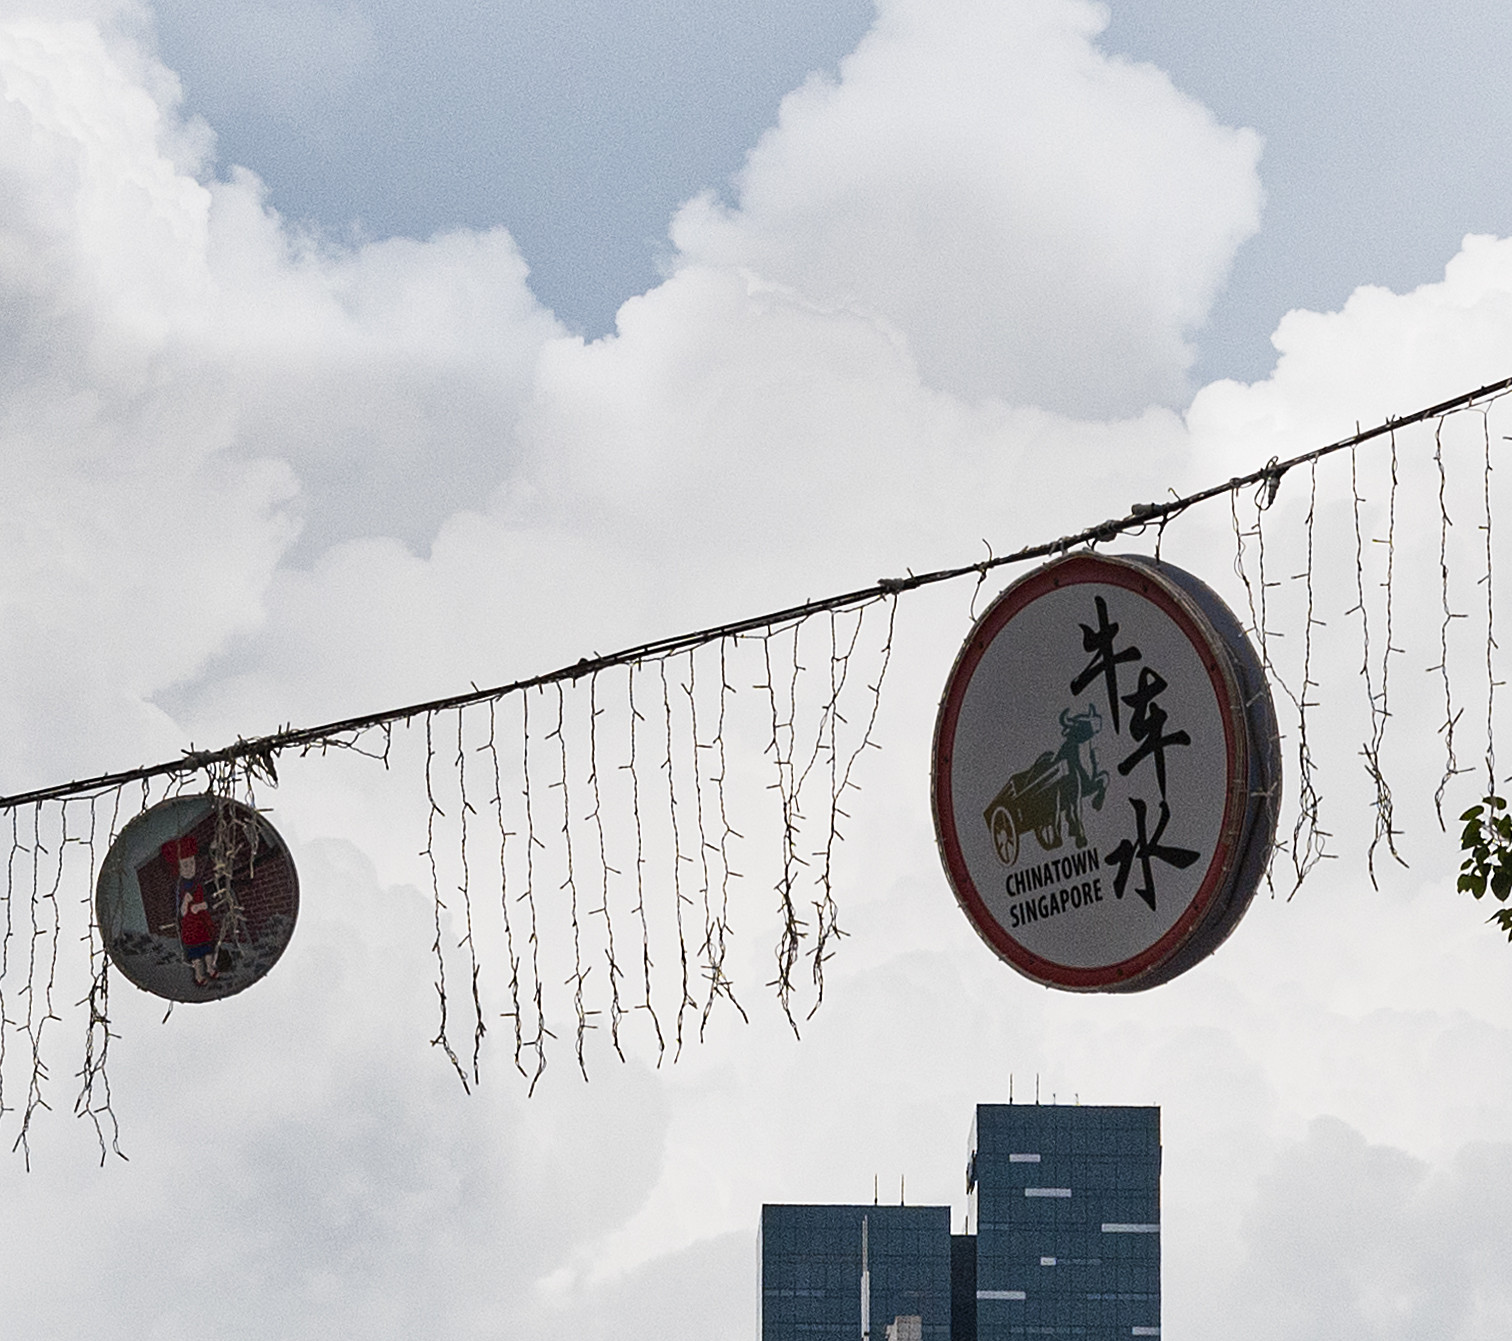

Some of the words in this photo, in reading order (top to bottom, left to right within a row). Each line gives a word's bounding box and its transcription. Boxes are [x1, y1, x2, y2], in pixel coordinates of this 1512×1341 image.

[1070, 596, 1200, 911] 牛车水
[1005, 849, 1100, 897] CHINATOWN
[1010, 878, 1103, 927] SINGAPORE
